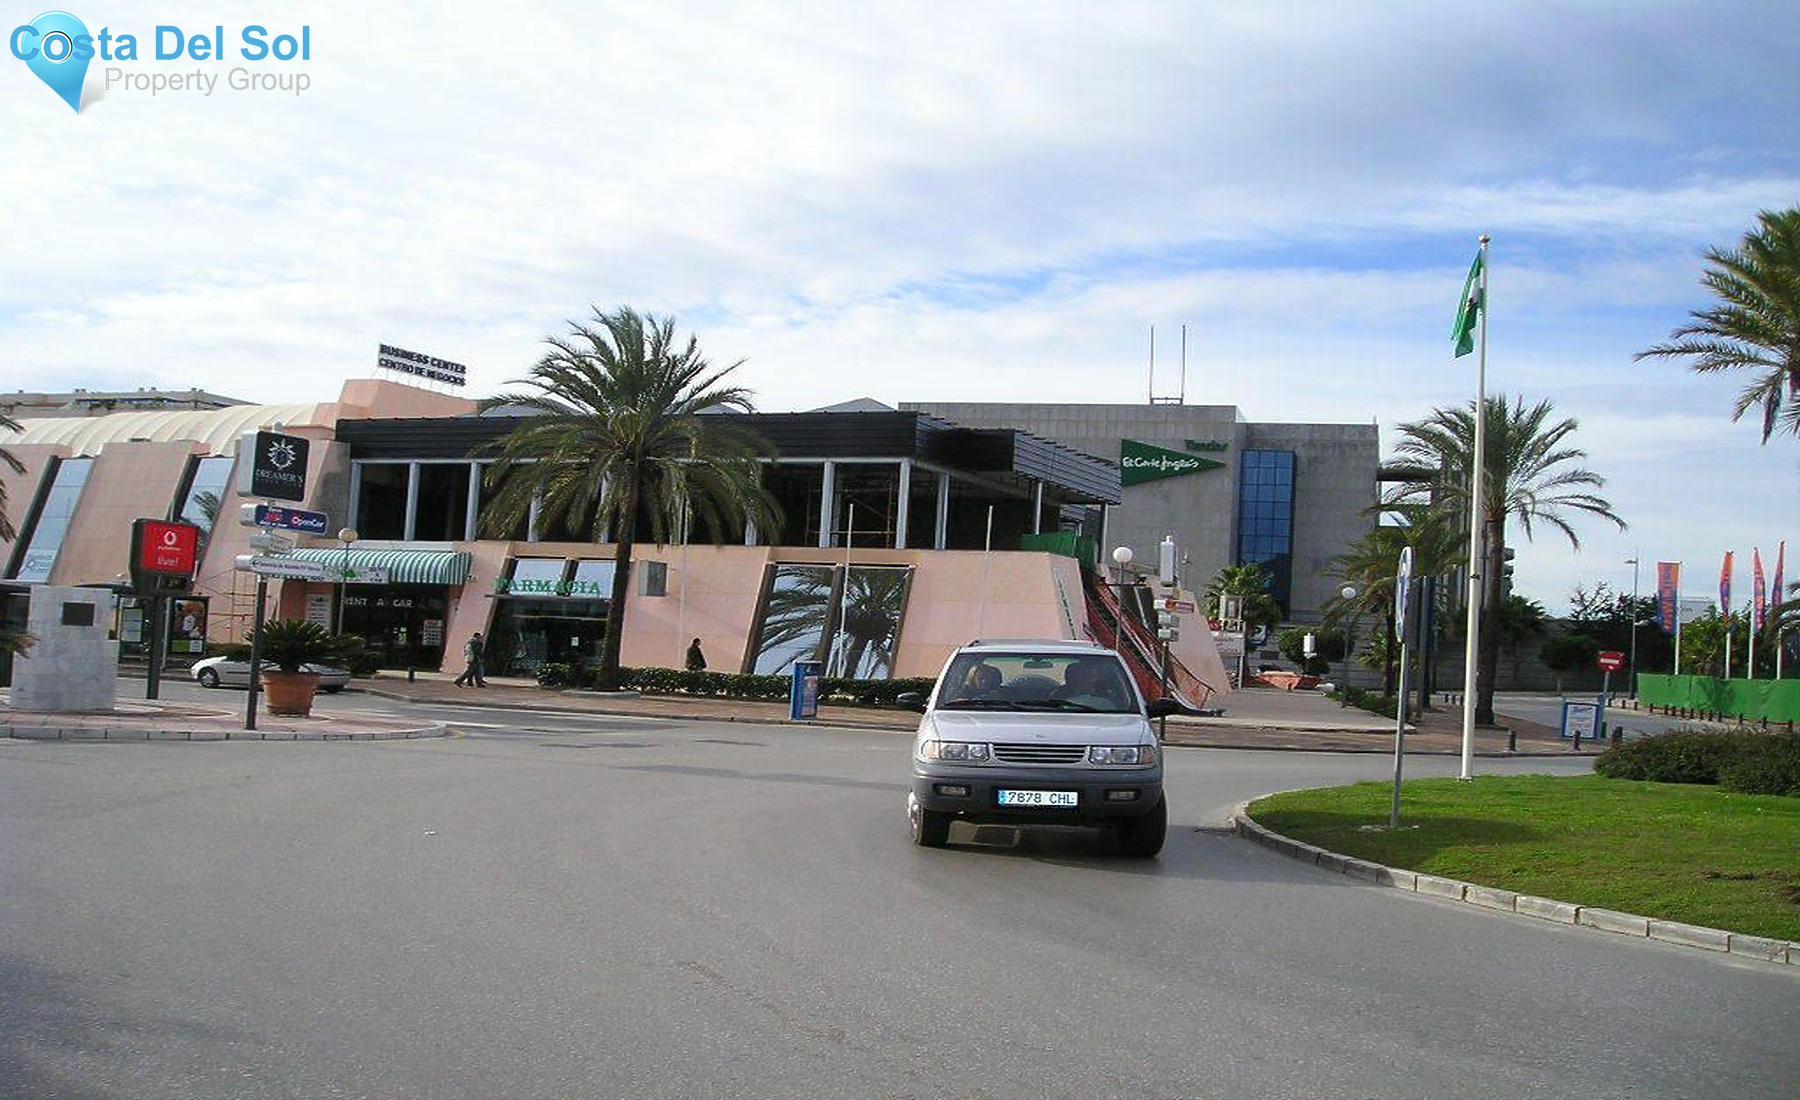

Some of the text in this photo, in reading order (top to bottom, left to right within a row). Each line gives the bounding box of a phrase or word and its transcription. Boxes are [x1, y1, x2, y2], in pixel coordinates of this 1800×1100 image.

[379, 343, 467, 375] BUSINESS CENTER
[379, 357, 414, 374] CENTRO
[414, 366, 426, 377] DE
[495, 576, 601, 595] FARMACIA
[393, 599, 413, 608] CAR
[1008, 791, 1076, 805] 7878 CHL
